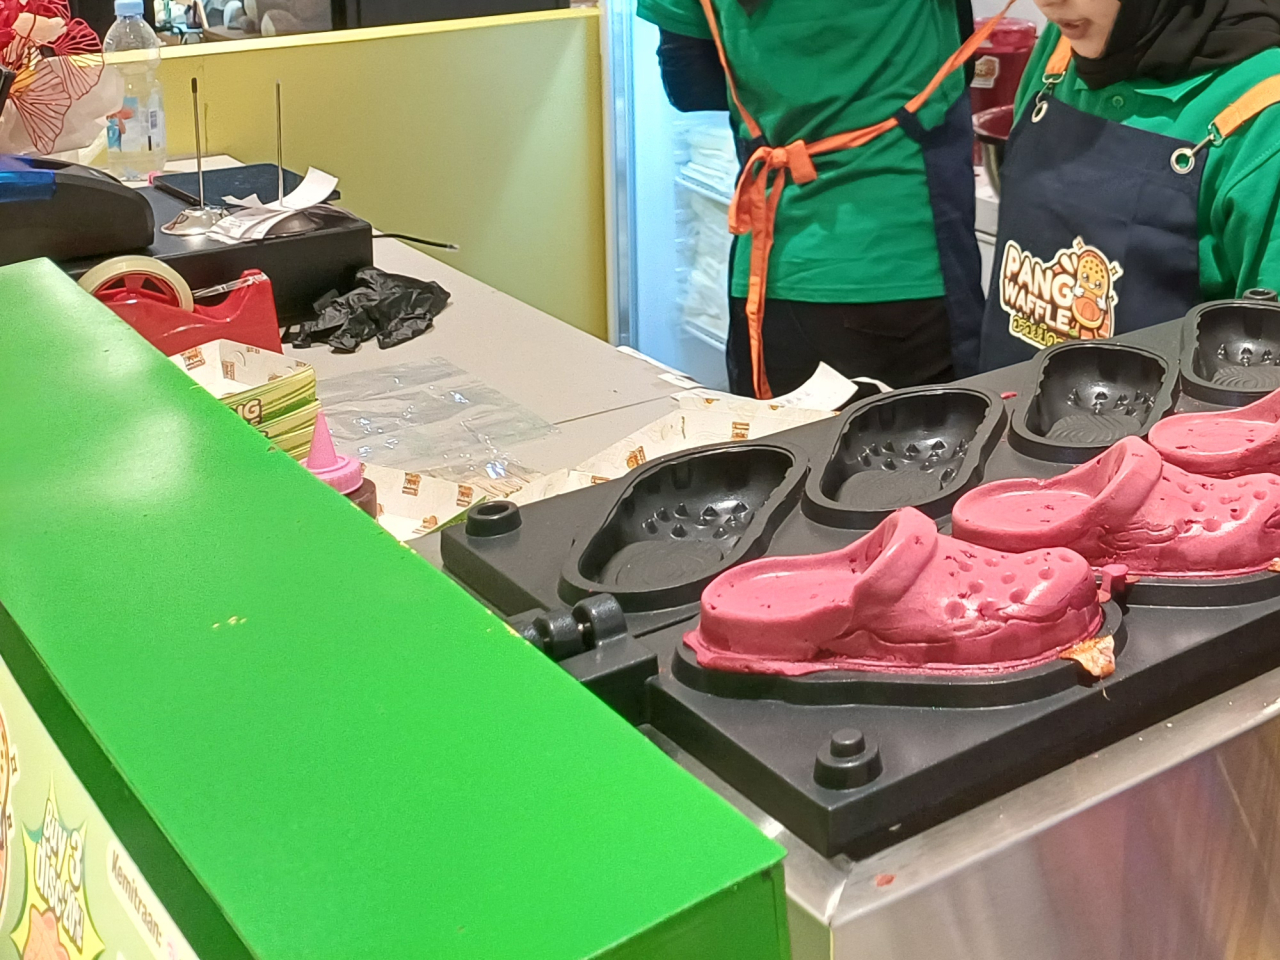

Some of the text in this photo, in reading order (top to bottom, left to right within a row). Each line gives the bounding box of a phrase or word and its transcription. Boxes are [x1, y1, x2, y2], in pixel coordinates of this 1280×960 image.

[1003, 277, 1073, 332] WAFFLE
[1004, 243, 1075, 308] PANG
[68, 828, 83, 891] 3
[111, 848, 163, 948] Kemitraan:
